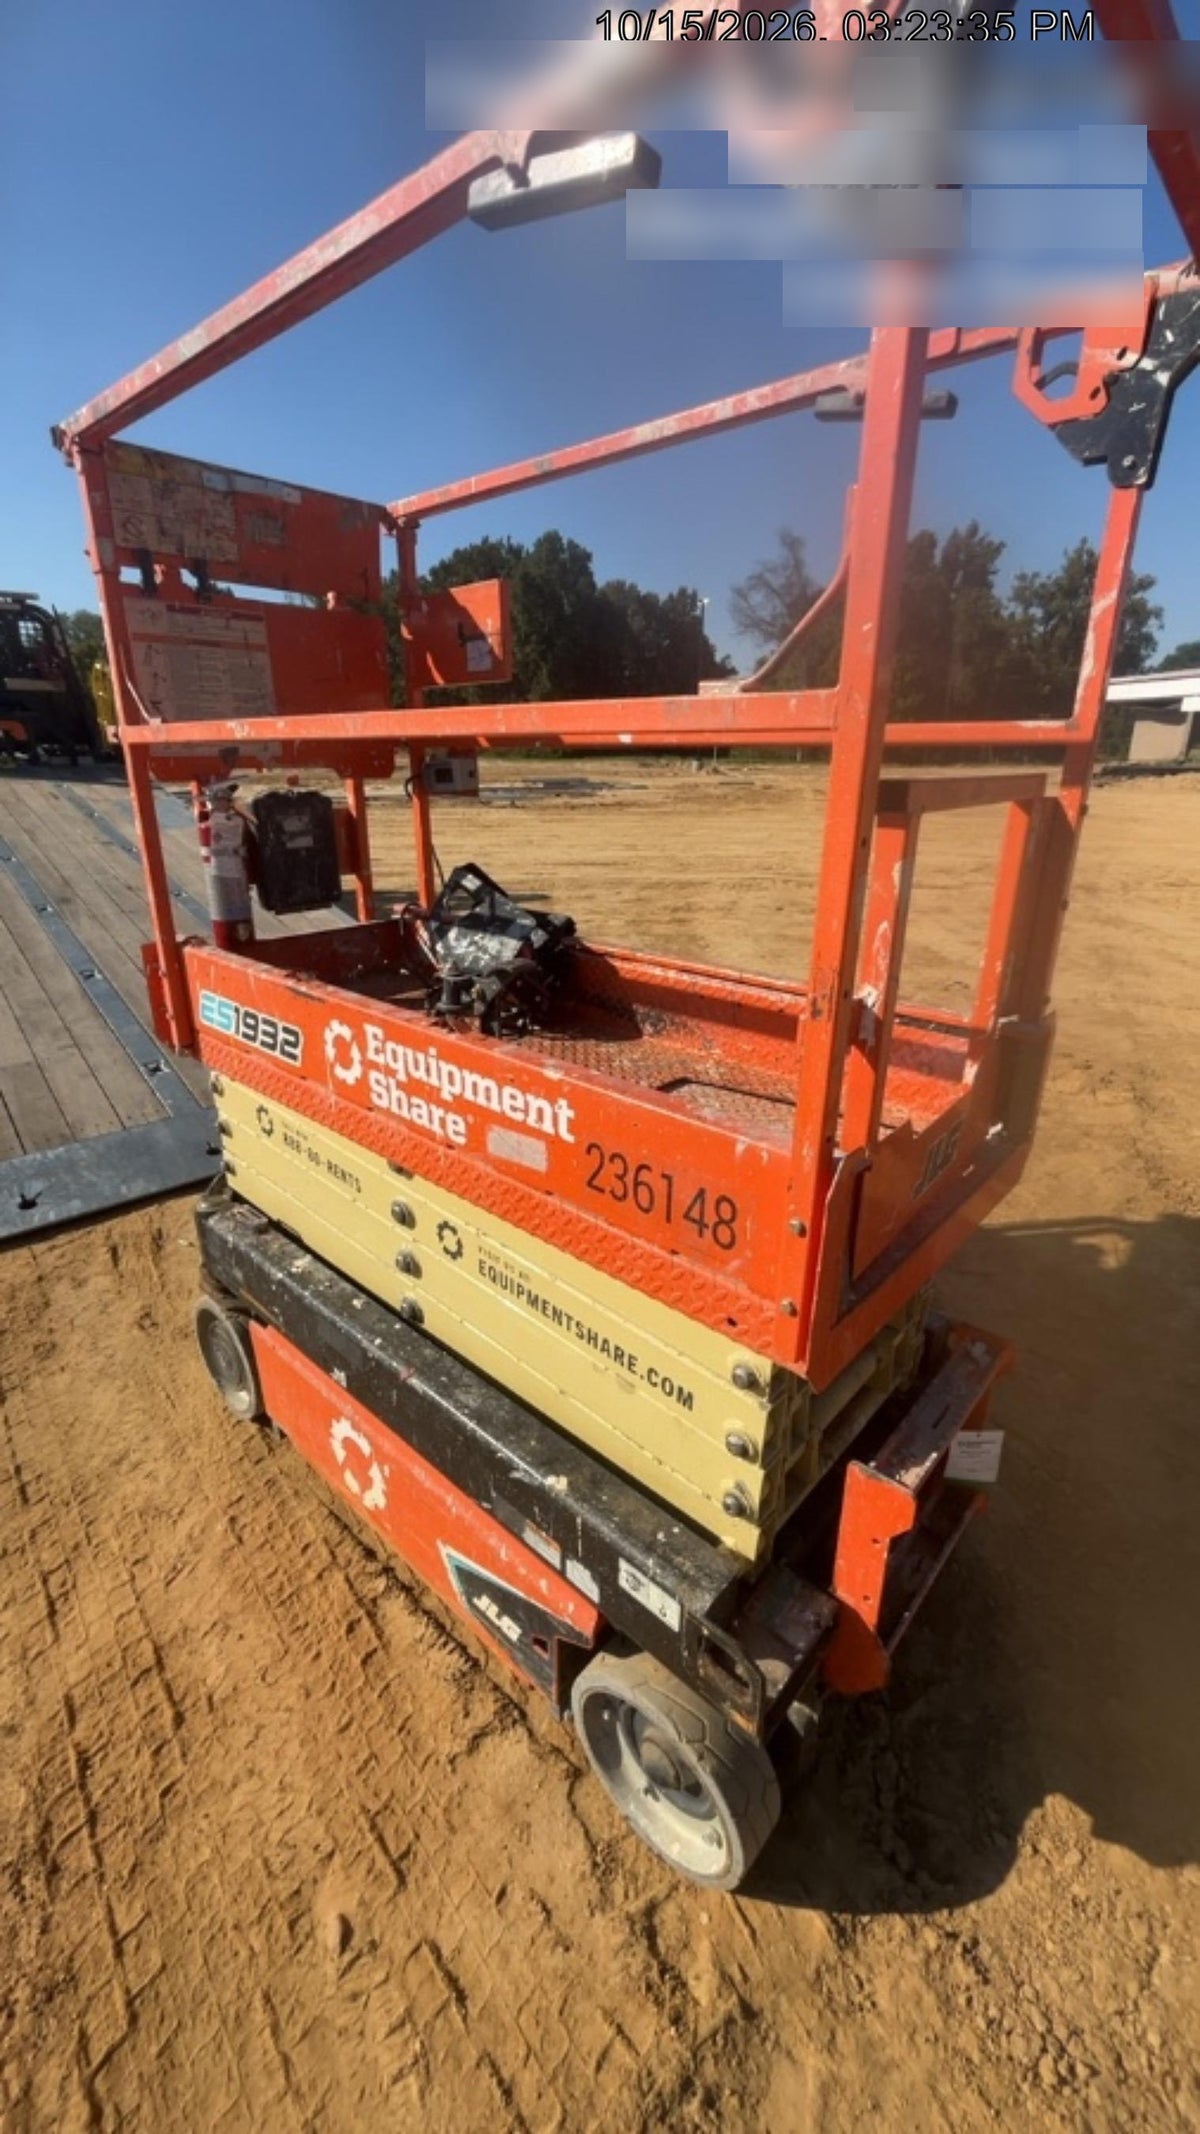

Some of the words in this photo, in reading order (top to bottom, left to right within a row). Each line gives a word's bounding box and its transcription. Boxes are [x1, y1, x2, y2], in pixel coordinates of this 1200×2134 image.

[200, 990, 301, 1063] ES1932
[363, 1023, 576, 1144] Equipment
[369, 1069, 468, 1146] Share
[584, 1141, 739, 1252] 236148
[477, 1257, 695, 1413] EQUIPMENTSHARE.COM
[472, 1593, 524, 1643] JLG
